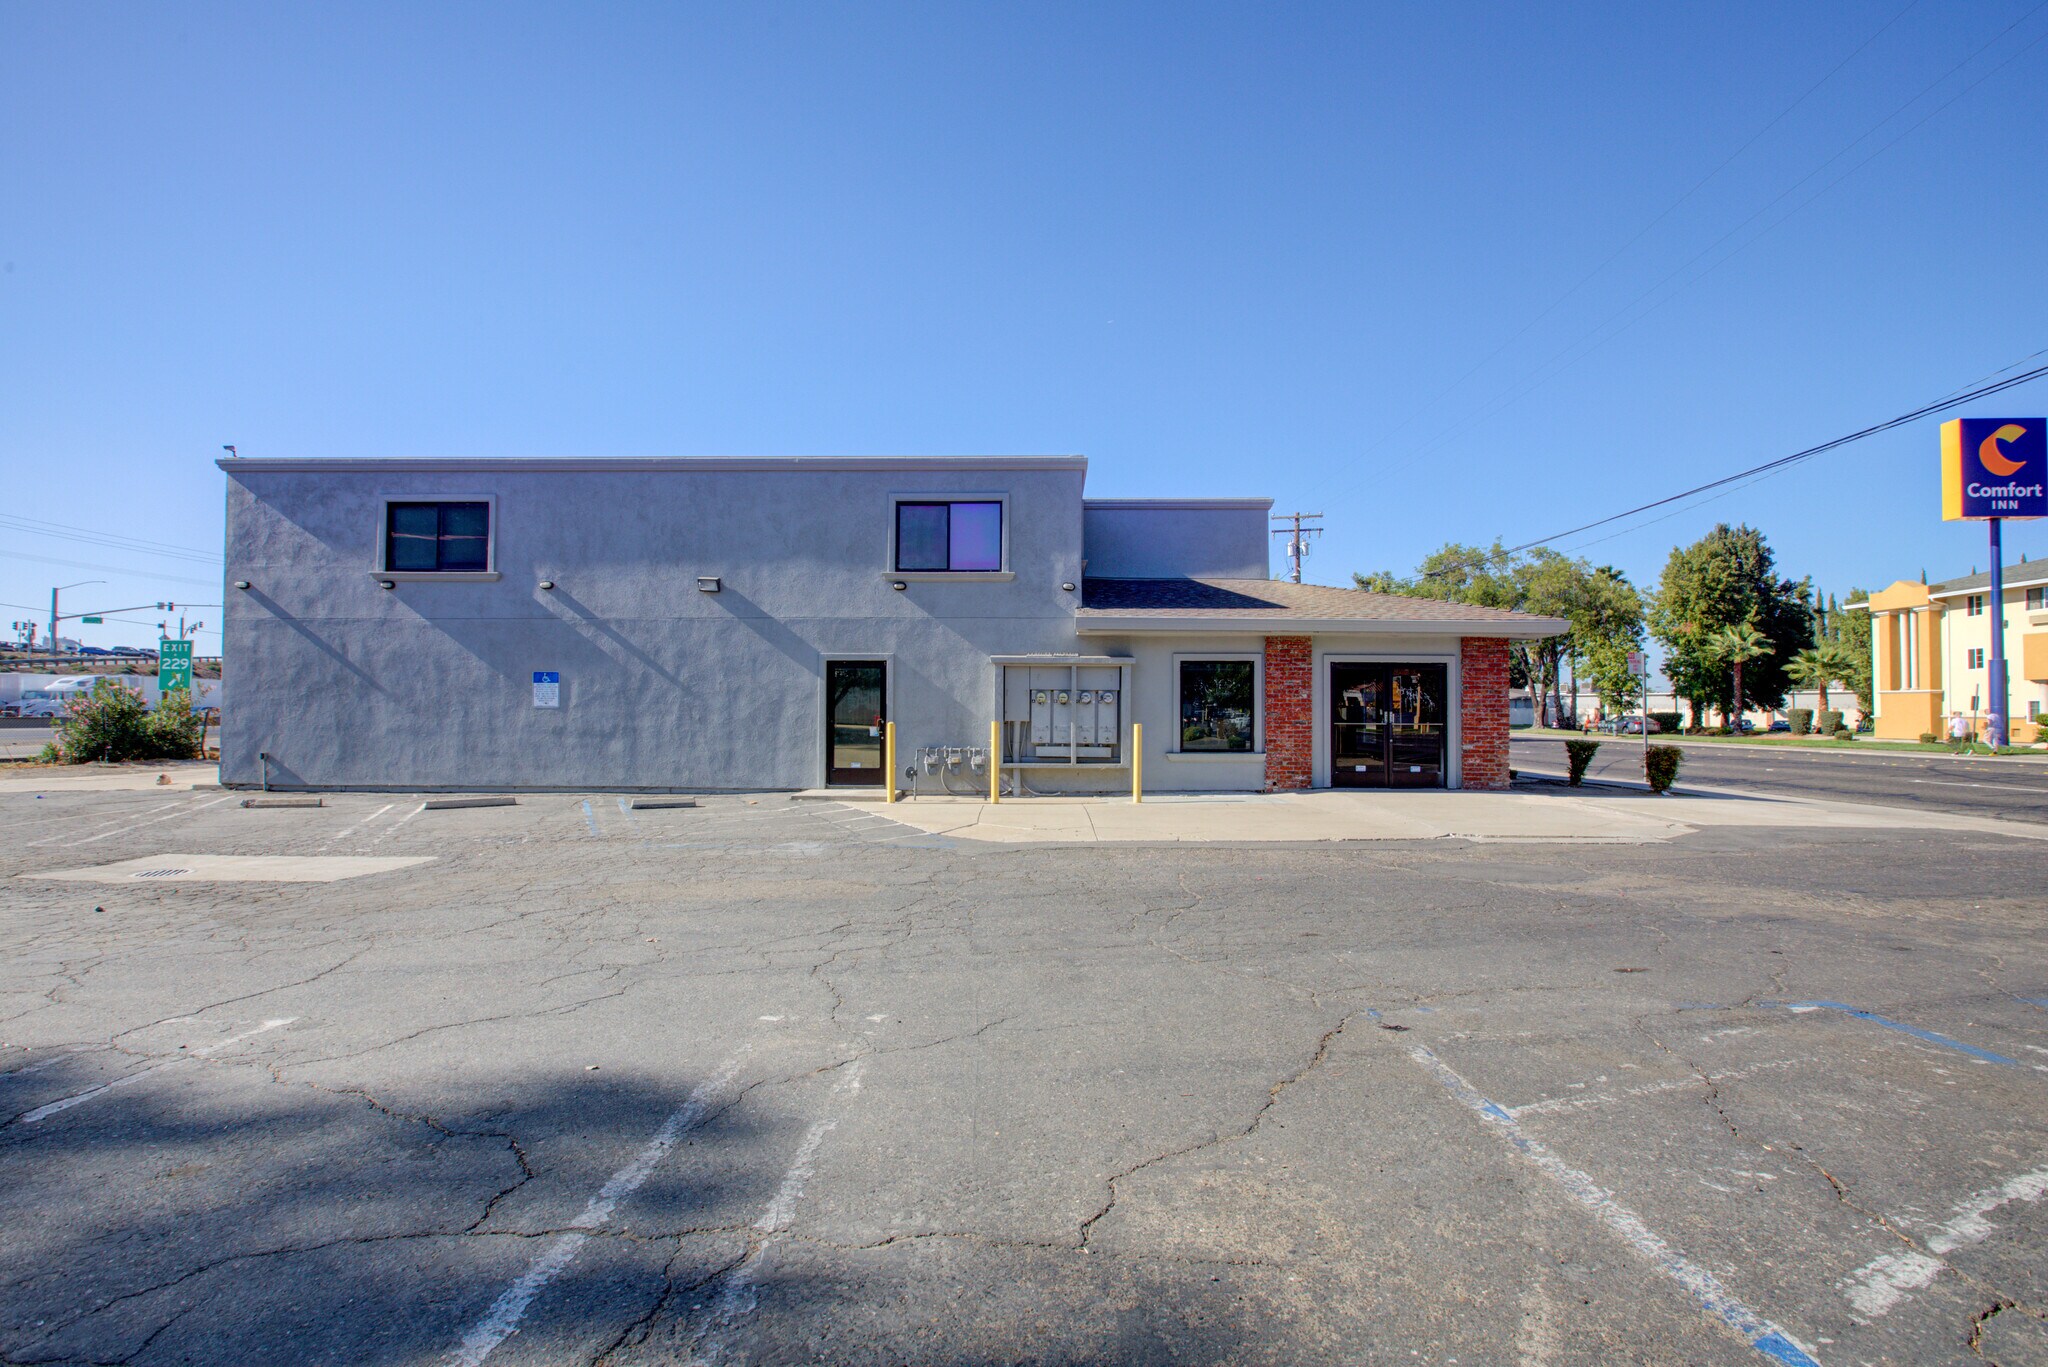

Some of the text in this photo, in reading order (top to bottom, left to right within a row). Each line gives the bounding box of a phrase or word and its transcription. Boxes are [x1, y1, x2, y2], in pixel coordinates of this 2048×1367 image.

[1967, 482, 2043, 498] Comfort
[1992, 500, 2019, 510] INN
[163, 643, 190, 652] EXIT
[162, 658, 190, 670] 229
